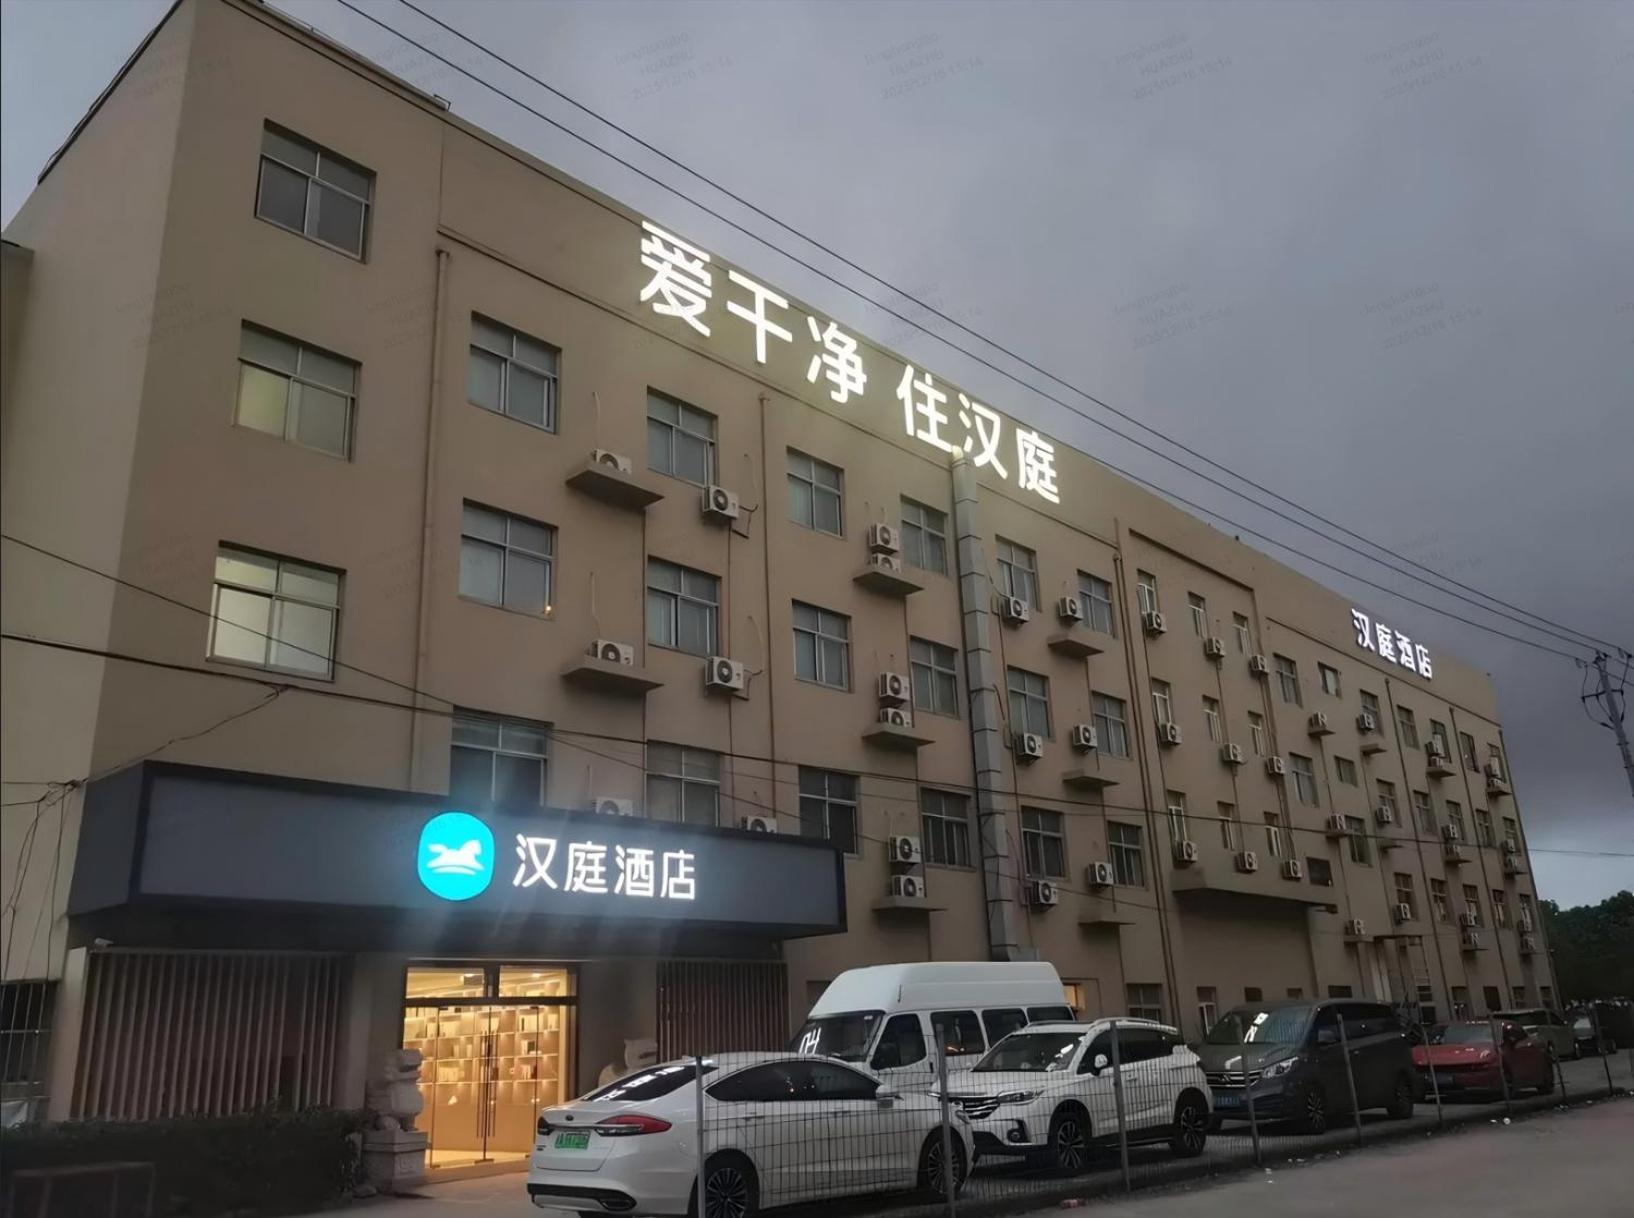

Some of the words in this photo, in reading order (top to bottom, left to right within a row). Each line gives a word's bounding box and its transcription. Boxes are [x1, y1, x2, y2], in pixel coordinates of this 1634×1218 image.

[640, 220, 867, 404] 爱干净
[897, 364, 1060, 504] 住汉庭
[1351, 608, 1432, 679] 汉庭酒店
[512, 833, 696, 900] 汉庭酒店
